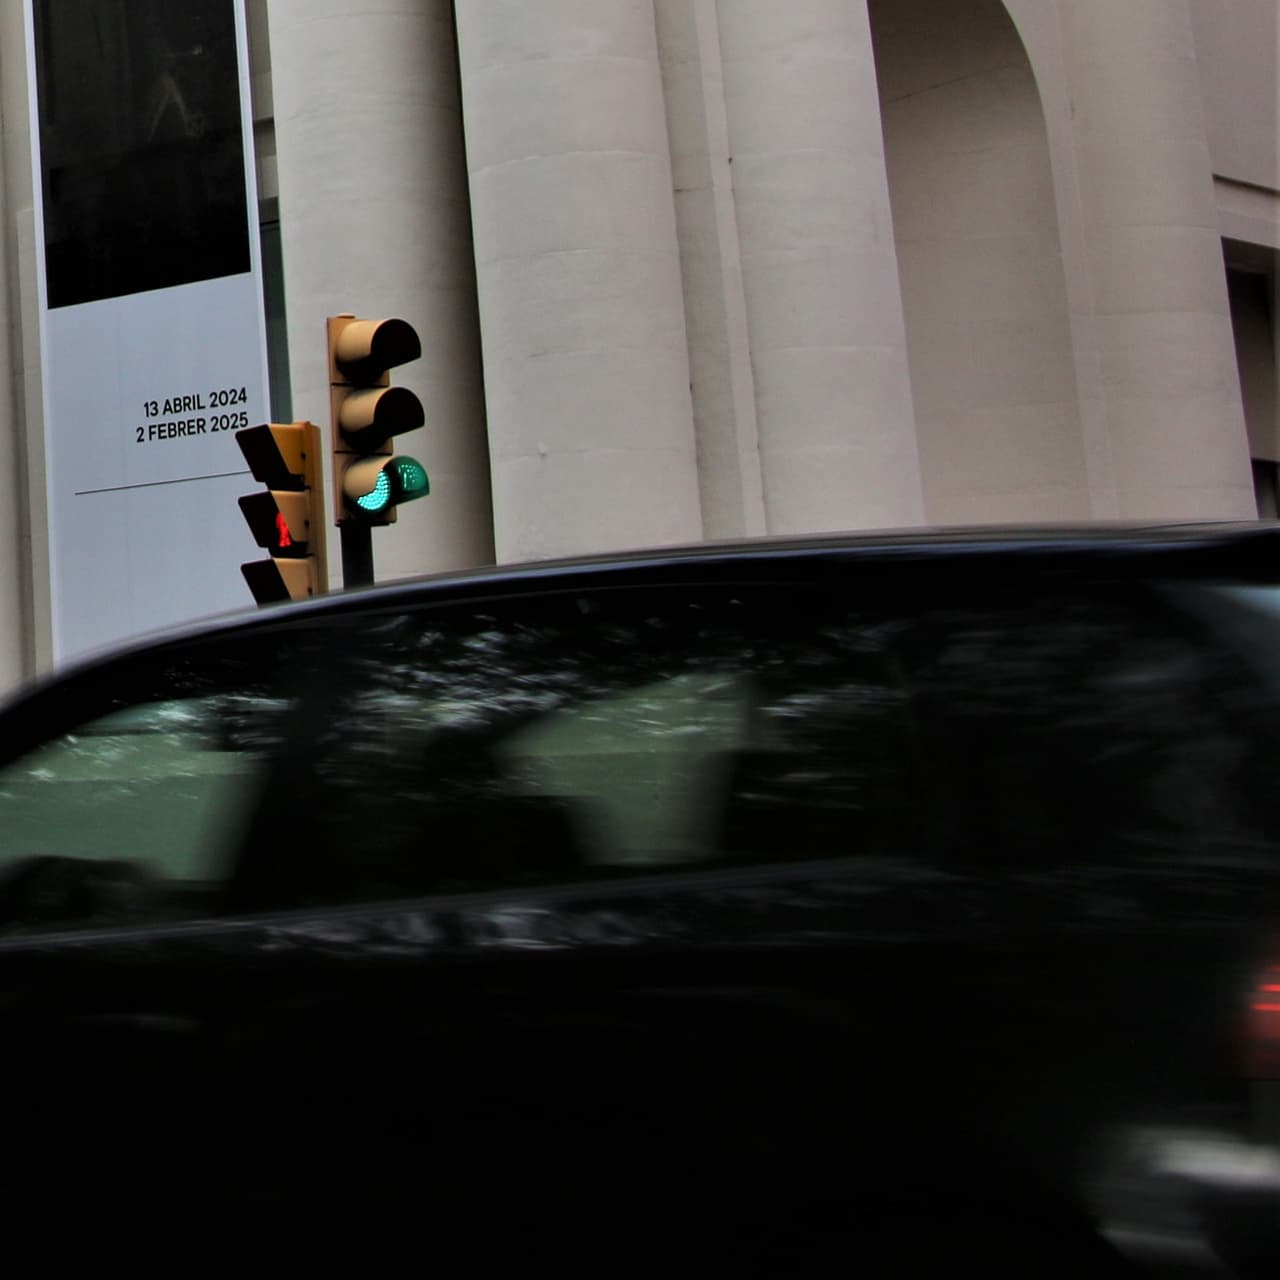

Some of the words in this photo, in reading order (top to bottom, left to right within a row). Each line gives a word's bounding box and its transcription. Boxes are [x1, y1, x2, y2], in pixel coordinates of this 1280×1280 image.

[144, 400, 159, 418] 13
[162, 393, 206, 416] ABRIL
[209, 386, 248, 409] 2024
[136, 426, 145, 443] 2
[148, 417, 207, 441] FEBRER
[210, 411, 249, 433] 2025
